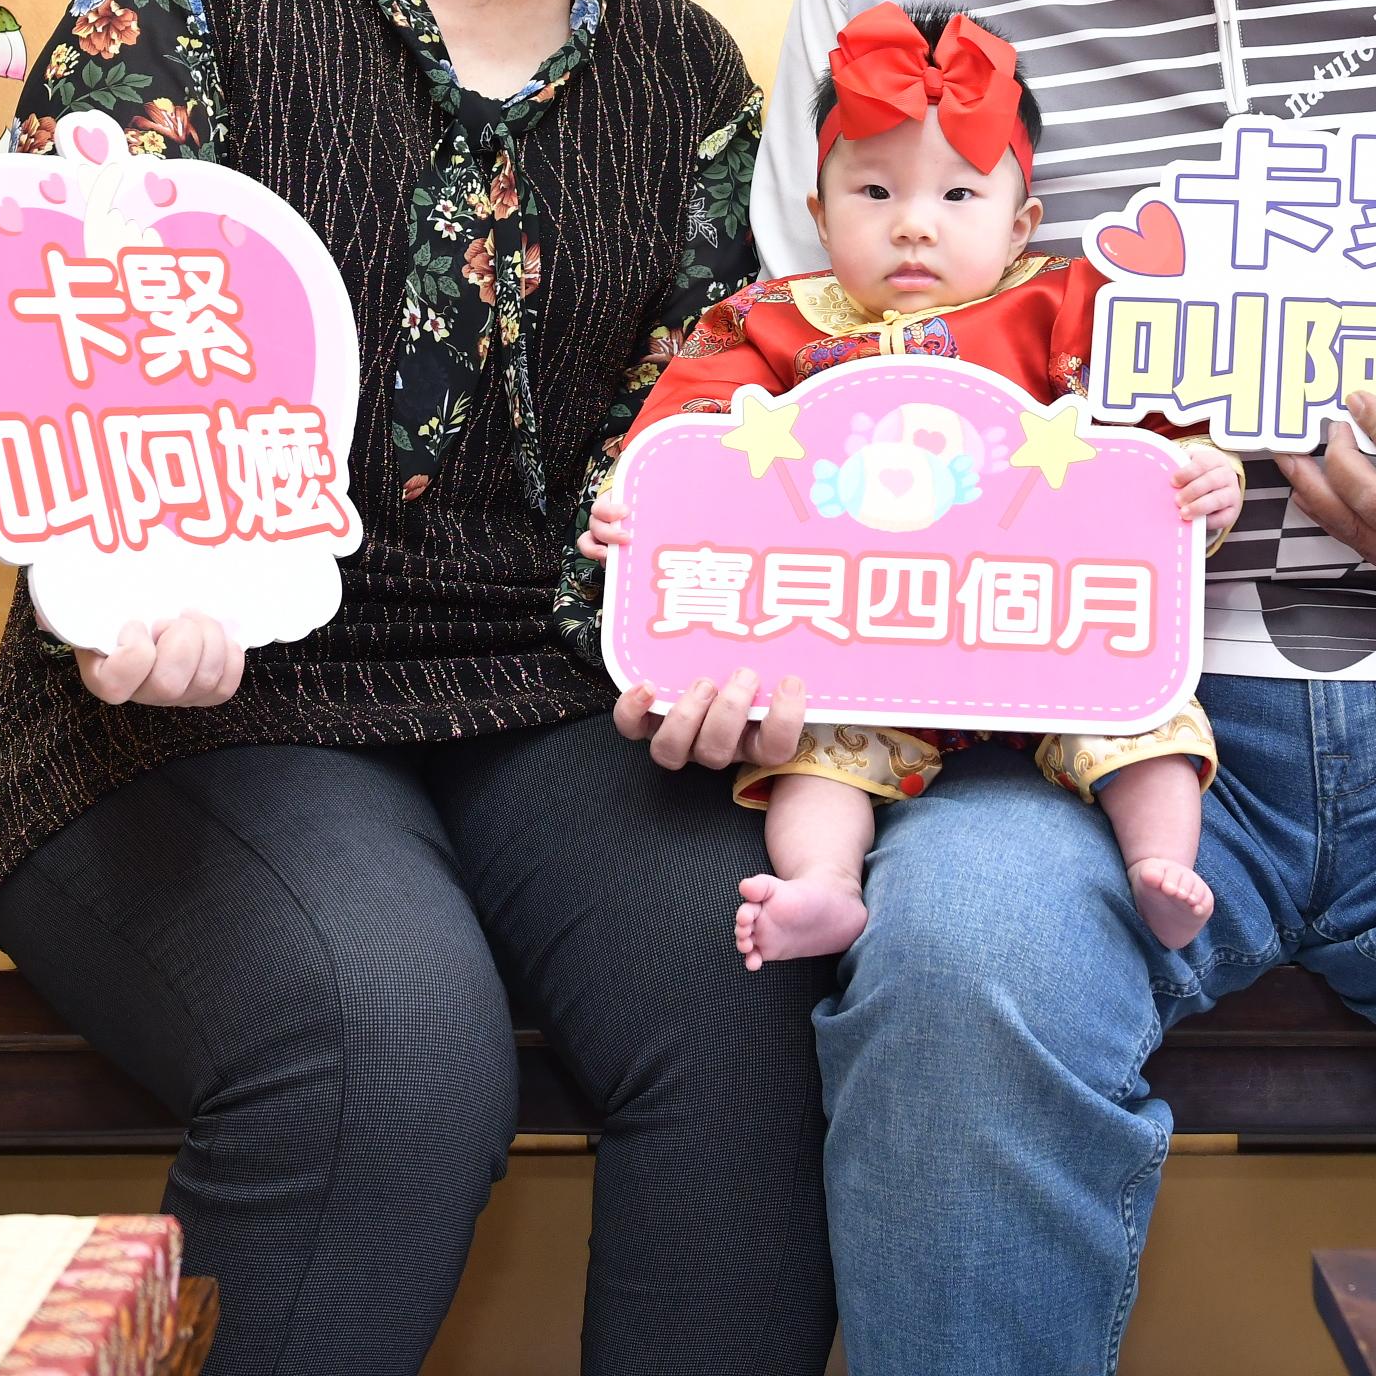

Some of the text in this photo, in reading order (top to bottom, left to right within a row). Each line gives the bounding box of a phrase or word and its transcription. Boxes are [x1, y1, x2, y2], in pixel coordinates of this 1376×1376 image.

[1284, 36, 1375, 120] nature
[10, 245, 254, 384] 卡緊
[652, 545, 1156, 654] 寶貝四個月
